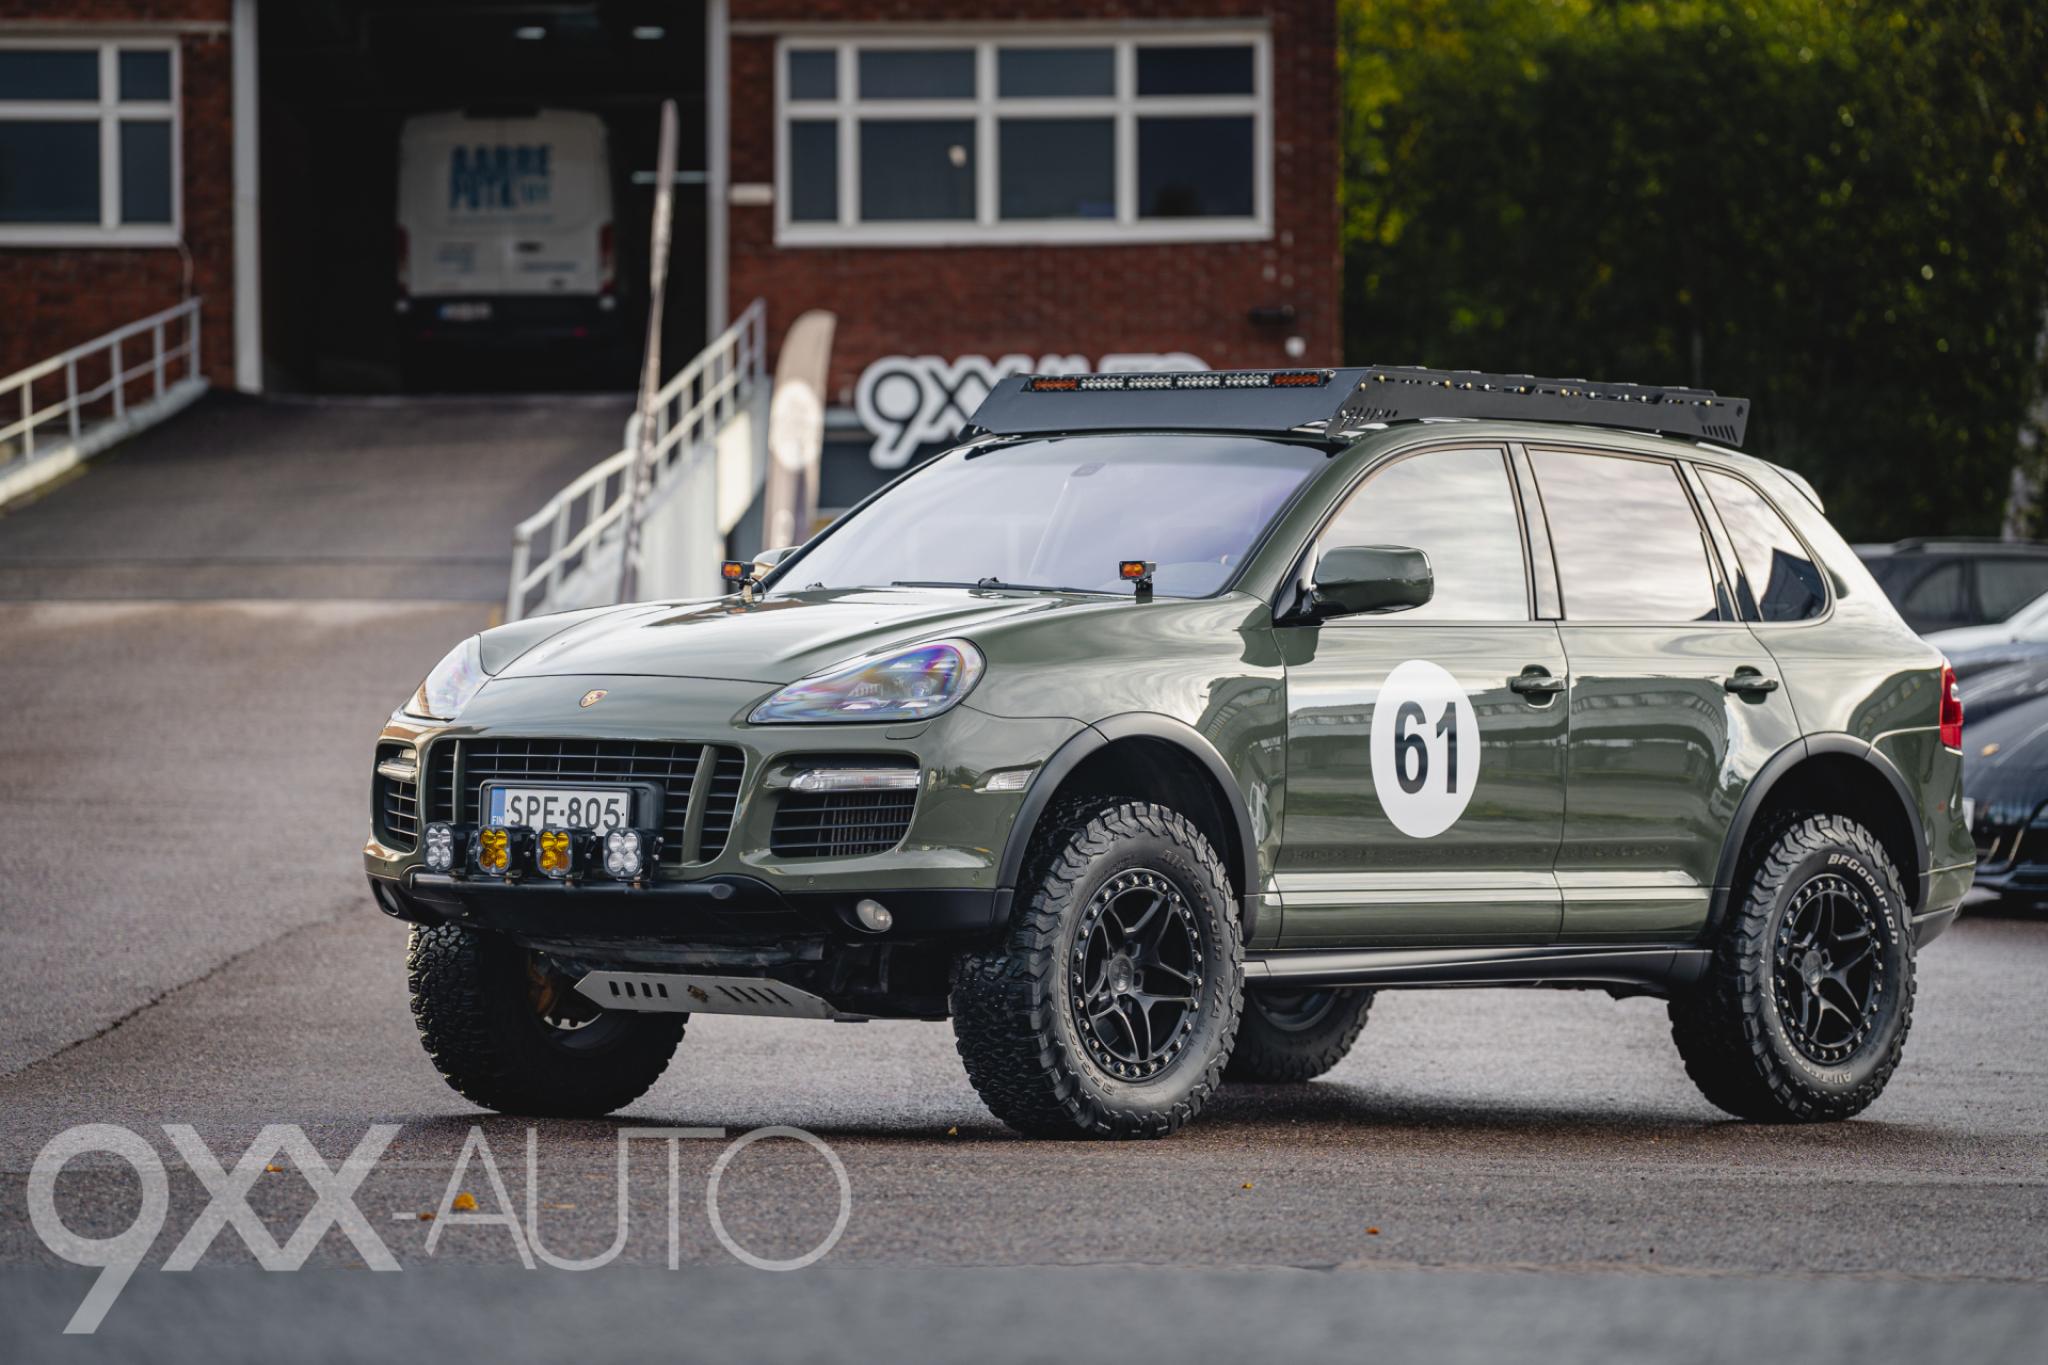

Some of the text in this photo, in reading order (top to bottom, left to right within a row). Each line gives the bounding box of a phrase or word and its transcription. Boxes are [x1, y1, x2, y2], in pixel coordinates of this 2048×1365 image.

[1394, 700, 1458, 795] 61
[491, 815, 504, 825] FIN
[510, 795, 621, 831] SPE-805
[1827, 853, 1898, 945] BFGoodrich
